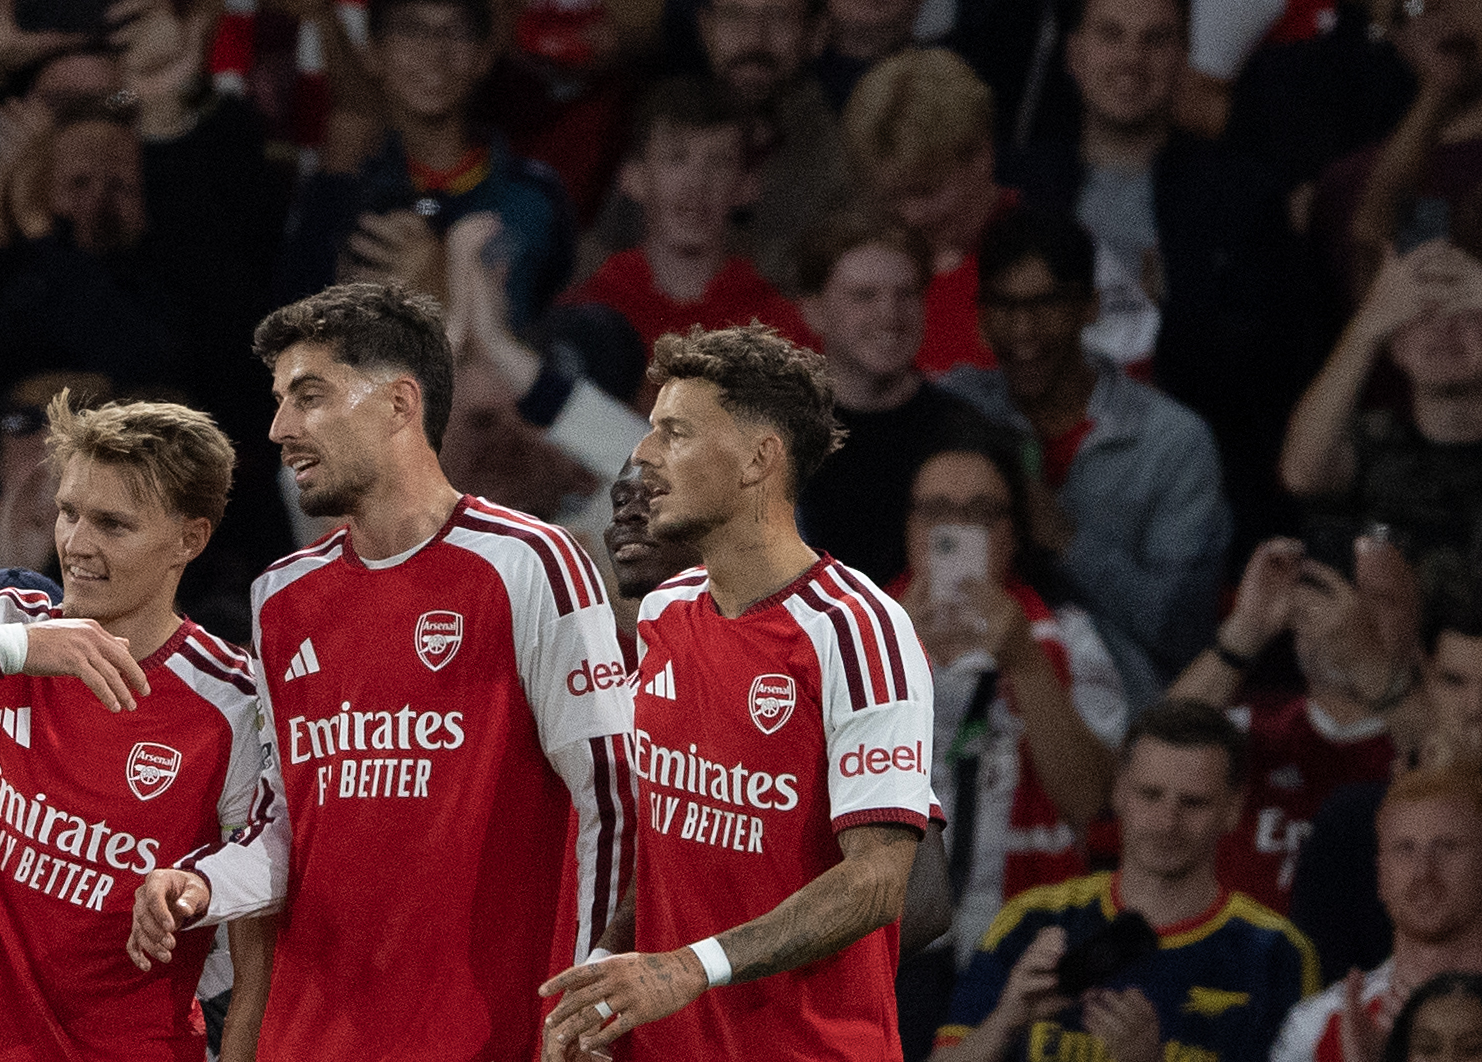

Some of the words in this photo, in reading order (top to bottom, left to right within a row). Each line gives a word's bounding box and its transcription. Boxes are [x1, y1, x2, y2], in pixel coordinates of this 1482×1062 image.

[423, 621, 457, 631] Arsenal
[567, 659, 625, 696] dee
[757, 683, 790, 695] Arsenal
[288, 701, 465, 765] Emirates
[137, 750, 174, 766] Arsenal
[635, 728, 799, 811] Emirates
[339, 759, 432, 798] BETTER
[681, 802, 763, 853] BETTER
[14, 846, 115, 912] BETTER
